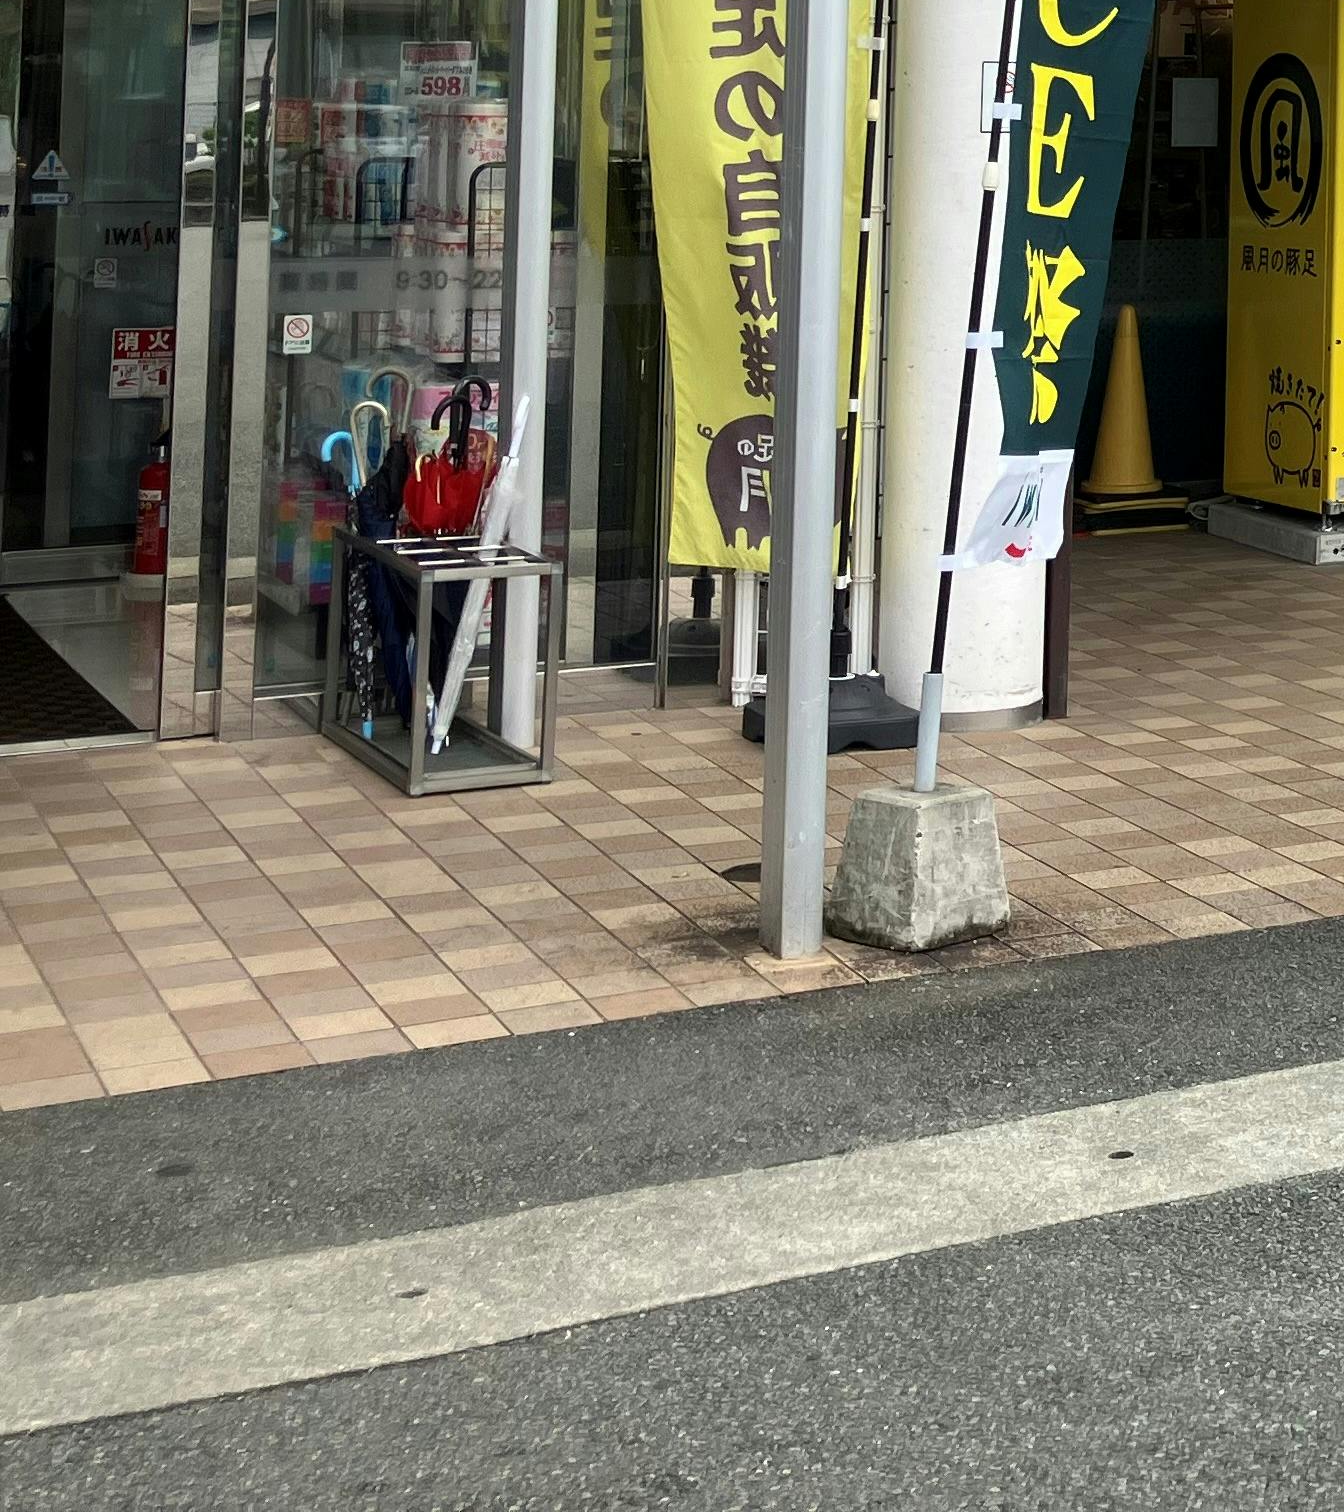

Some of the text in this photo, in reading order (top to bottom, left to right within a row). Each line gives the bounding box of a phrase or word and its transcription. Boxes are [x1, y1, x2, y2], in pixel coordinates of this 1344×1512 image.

[421, 76, 461, 96] 598
[1241, 245, 1317, 277] 風月の豚足
